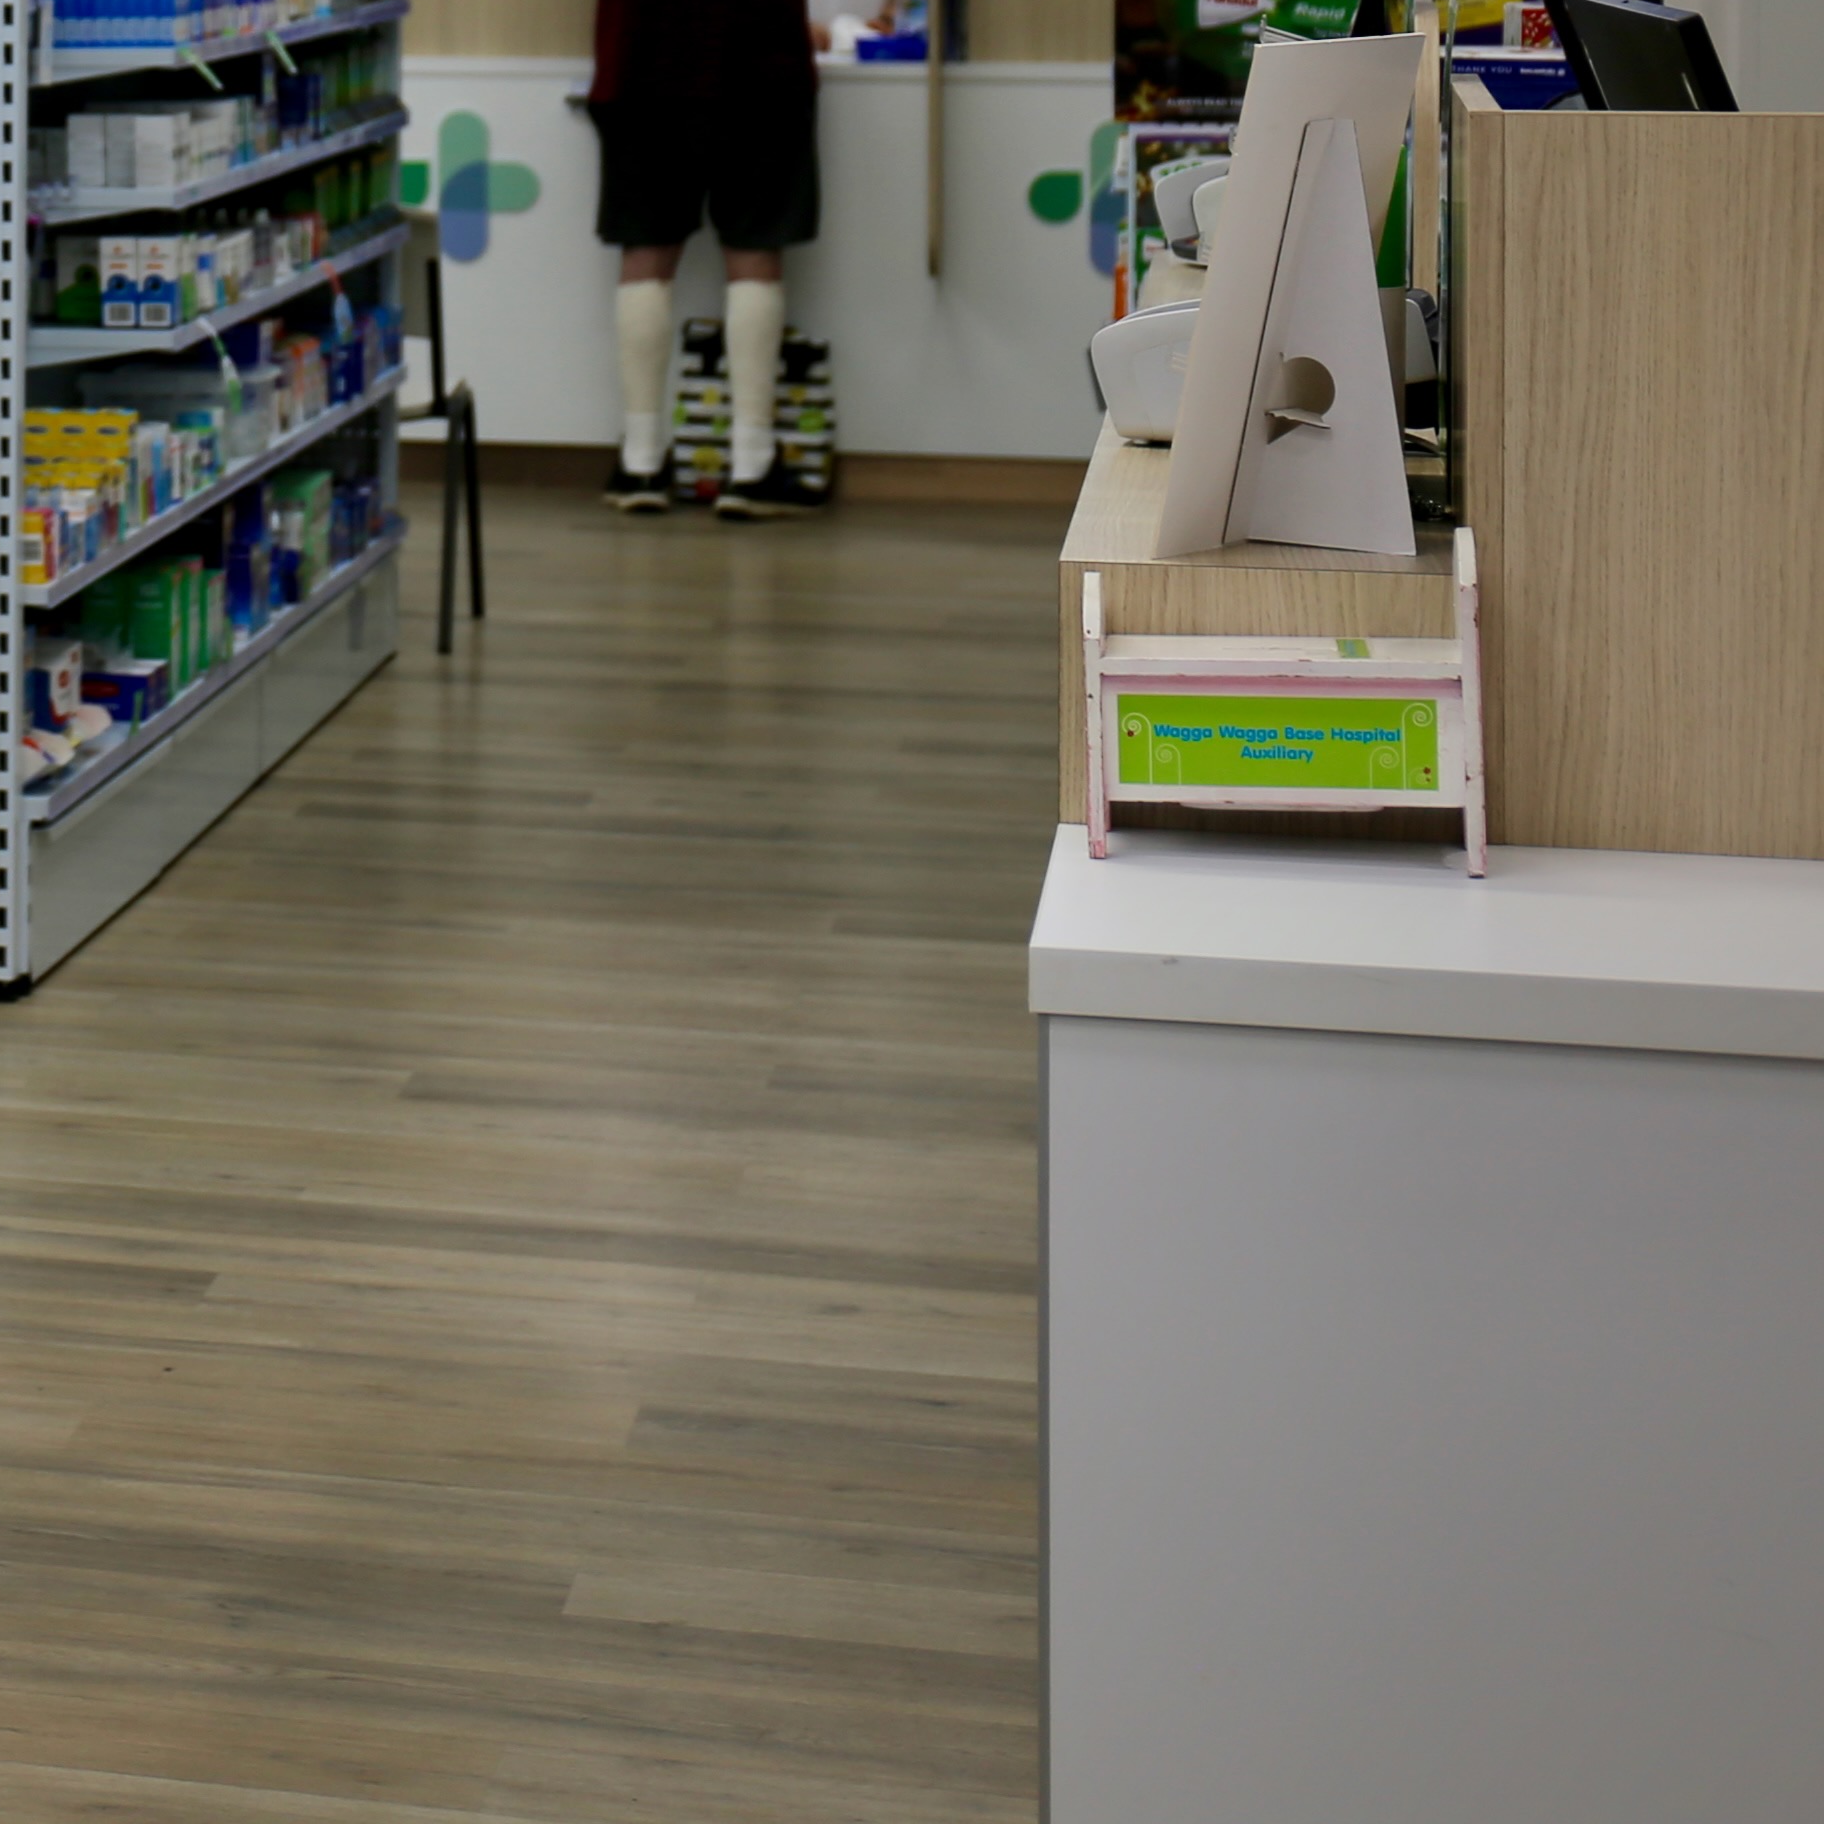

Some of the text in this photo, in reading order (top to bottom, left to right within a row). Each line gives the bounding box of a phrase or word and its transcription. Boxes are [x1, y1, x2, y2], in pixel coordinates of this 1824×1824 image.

[1294, 1, 1346, 21] Rapid
[1153, 724, 1400, 745] Wagga Wagga Base Hospital
[1241, 745, 1314, 764] Auxiliary
